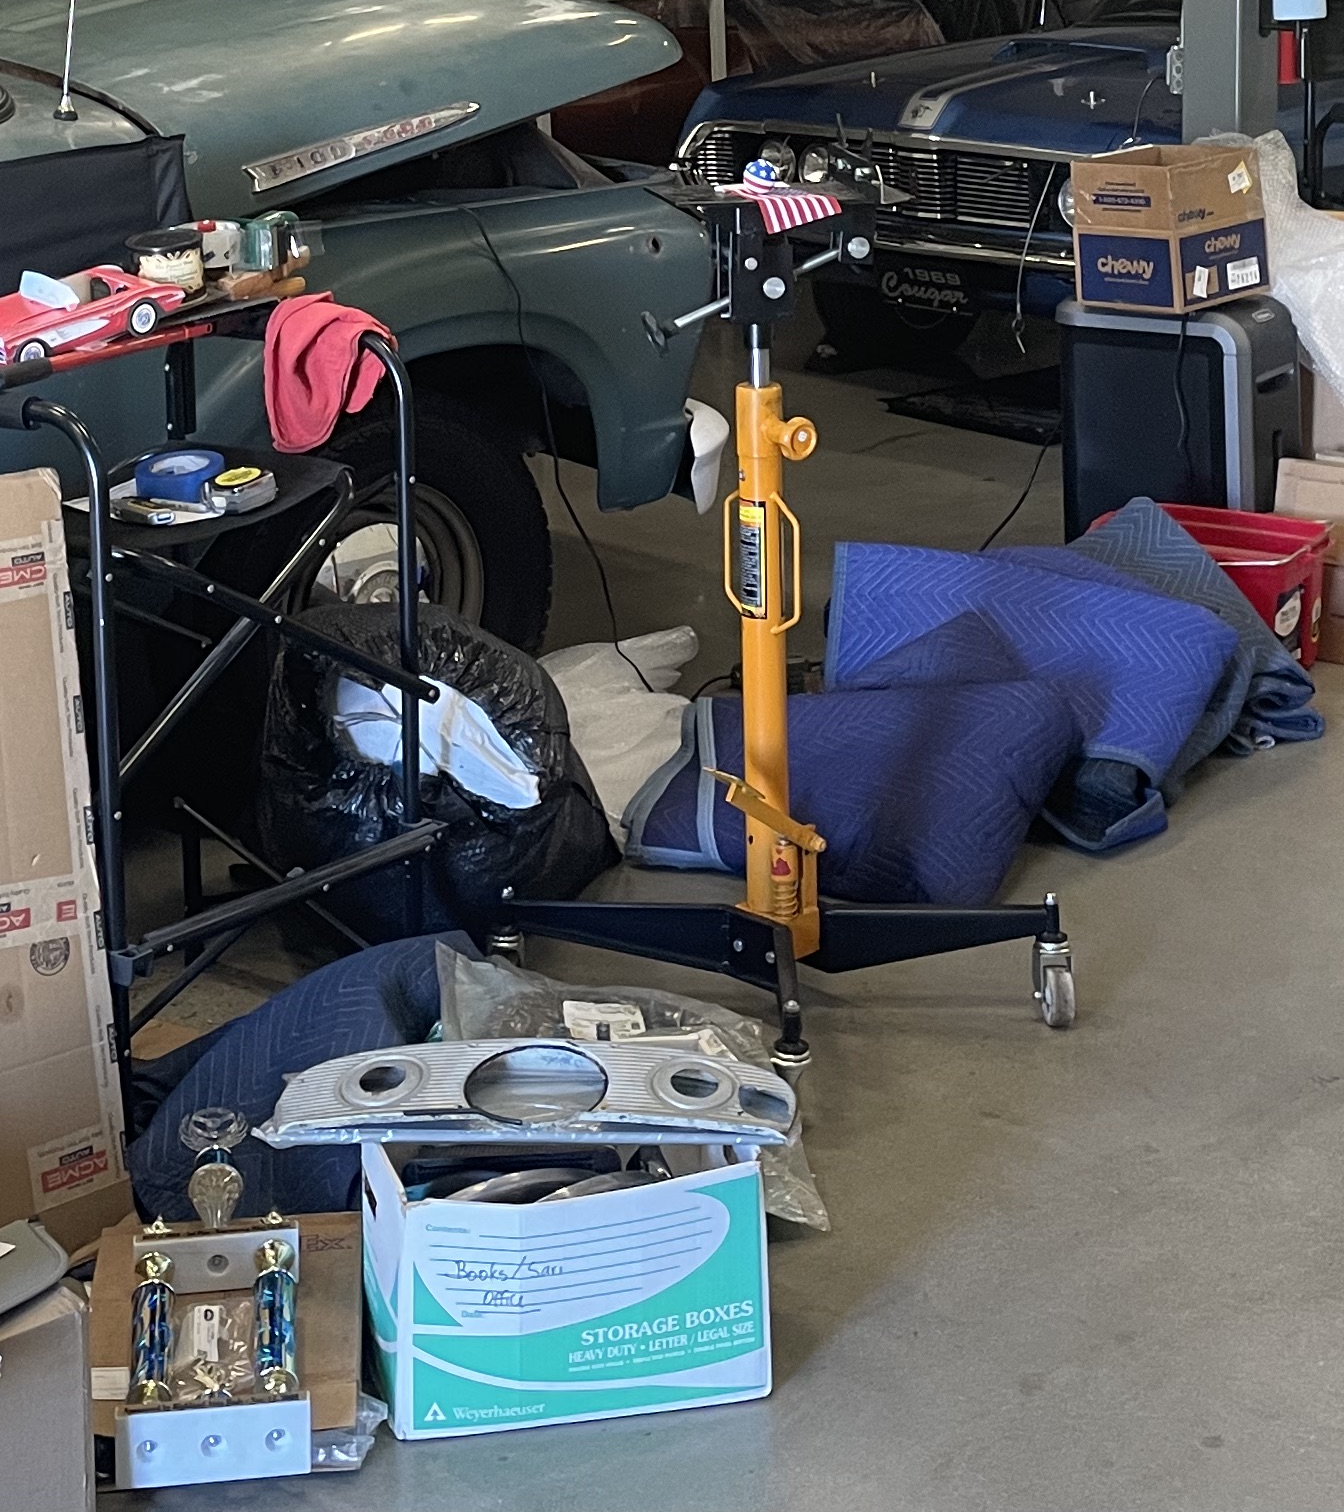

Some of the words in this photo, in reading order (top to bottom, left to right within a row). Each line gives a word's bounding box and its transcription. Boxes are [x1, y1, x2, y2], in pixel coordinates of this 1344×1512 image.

[1204, 233, 1241, 253] chewy
[903, 267, 961, 285] 1969
[1097, 254, 1154, 280] chewy
[881, 271, 969, 307] Cougar
[64, 594, 74, 628] AUTO
[74, 698, 83, 732] AUTO
[95, 914, 105, 948] AUTO
[61, 1148, 91, 1164] AUTO
[46, 1157, 107, 1188] ACME
[580, 1314, 680, 1346] STORAGE
[685, 1299, 754, 1329] BOXES
[568, 1347, 605, 1364] HEAVY
[607, 1343, 638, 1359] DUTY
[648, 1335, 688, 1352] LETTER
[697, 1326, 730, 1343] LEGAL
[732, 1320, 755, 1336] SIZE
[452, 1402, 546, 1422] Weyerhaeuser
